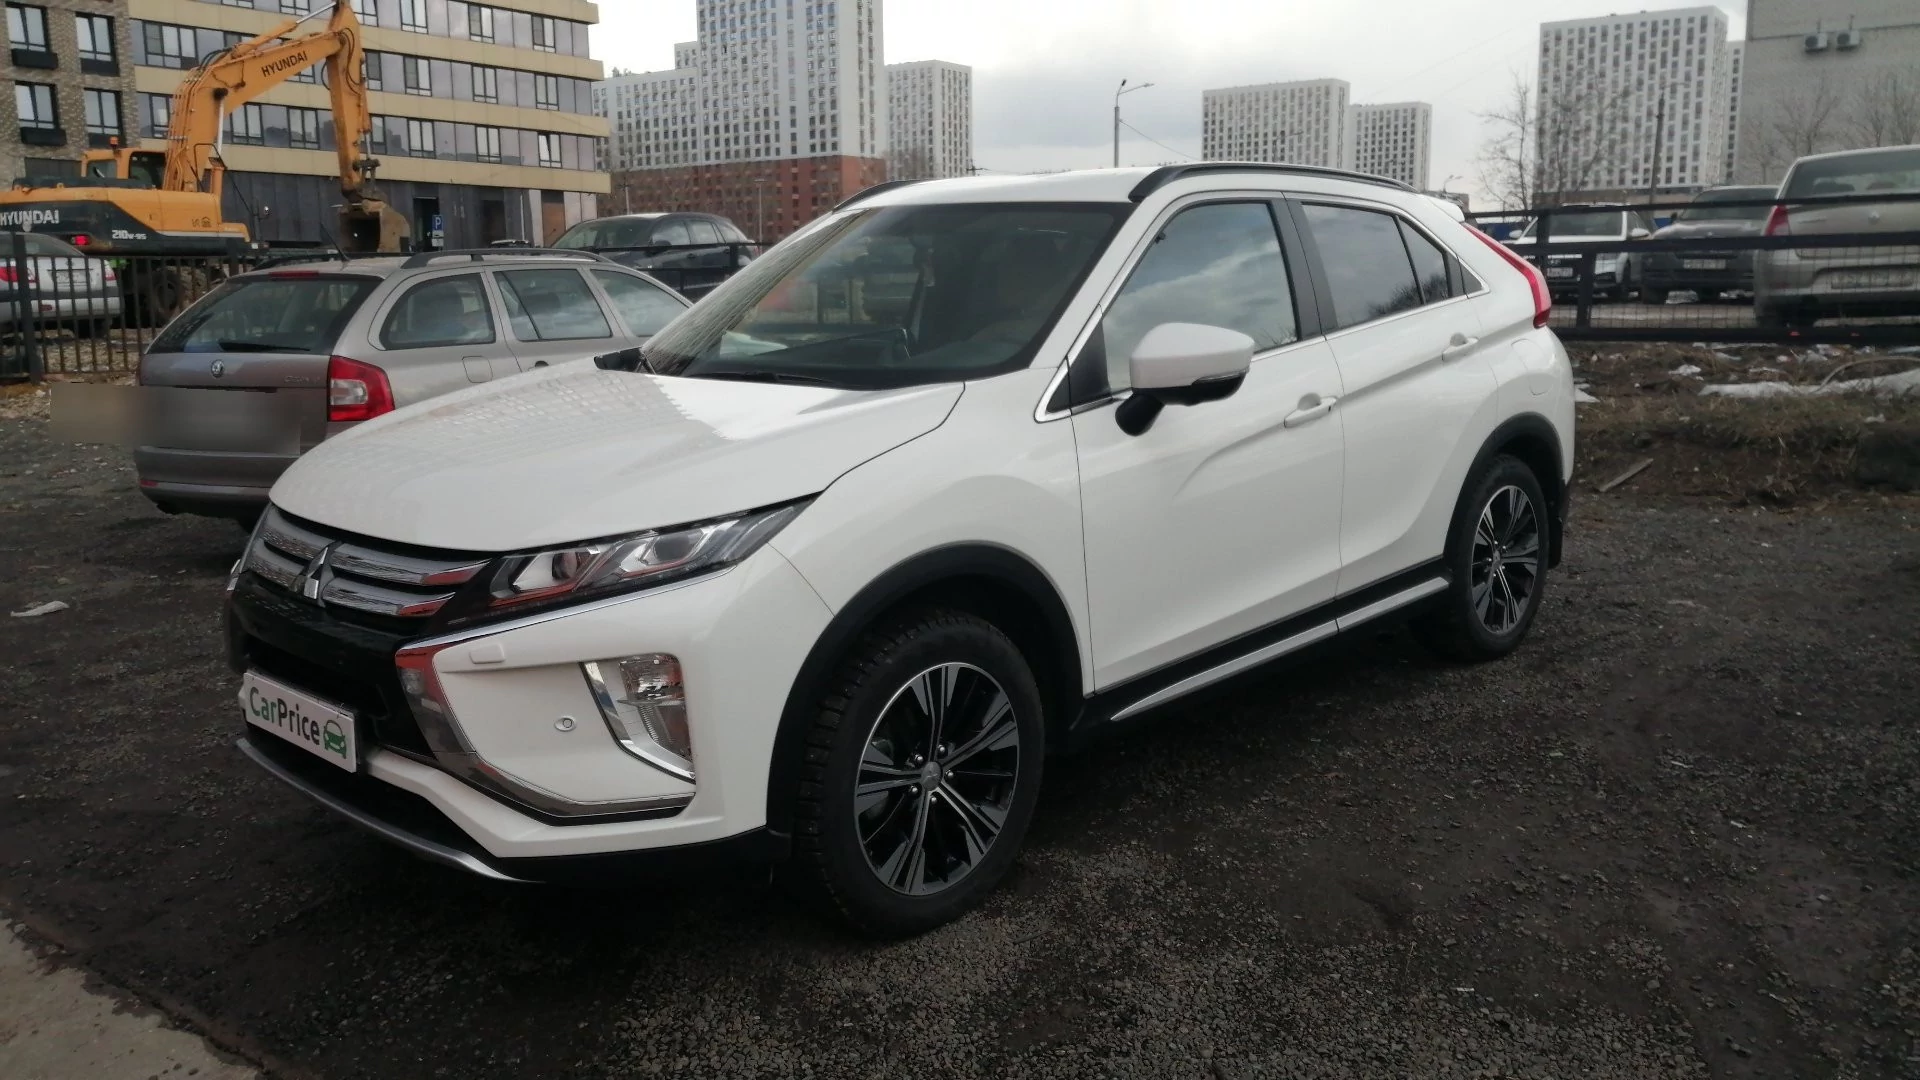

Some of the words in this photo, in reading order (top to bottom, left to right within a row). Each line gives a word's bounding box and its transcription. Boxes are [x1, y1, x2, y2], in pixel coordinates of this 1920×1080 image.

[261, 50, 308, 77] HYUNDAI
[0, 209, 60, 226] HYUNDAI
[249, 686, 321, 746] CarPrice
